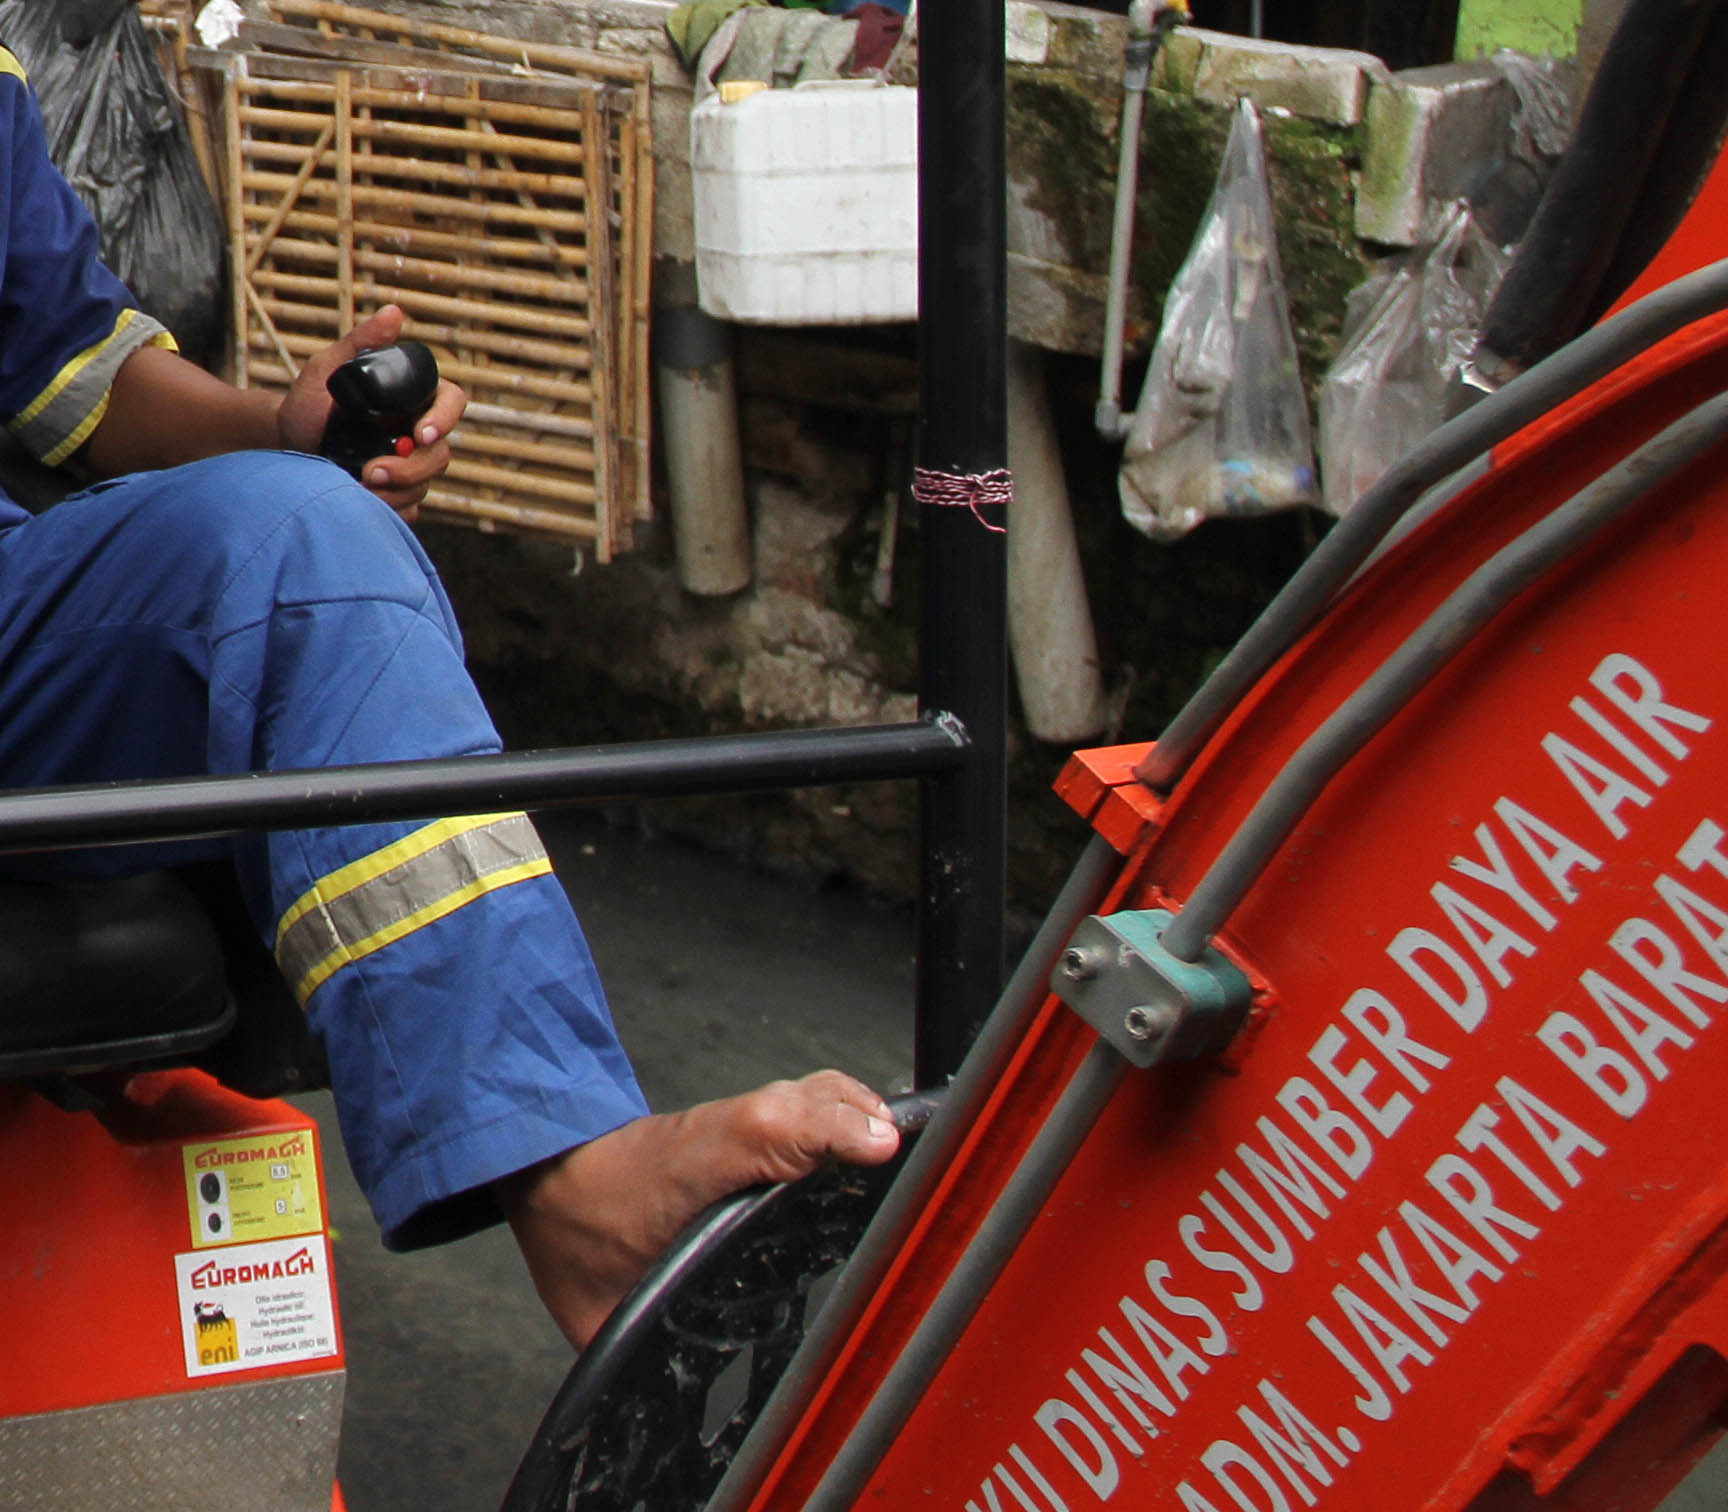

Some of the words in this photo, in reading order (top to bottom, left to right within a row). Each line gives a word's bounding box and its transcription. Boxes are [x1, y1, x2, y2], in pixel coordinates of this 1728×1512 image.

[1033, 1259, 1229, 1502] DINAS
[1178, 987, 1452, 1312] SUMBER
[1385, 796, 1604, 1035] DAYA
[1540, 652, 1714, 841] AIR
[194, 1135, 306, 1170] EUROMACH
[190, 1246, 315, 1291] EUROMACH
[1306, 1074, 1609, 1421] JAKARTA
[200, 1337, 235, 1365] eni
